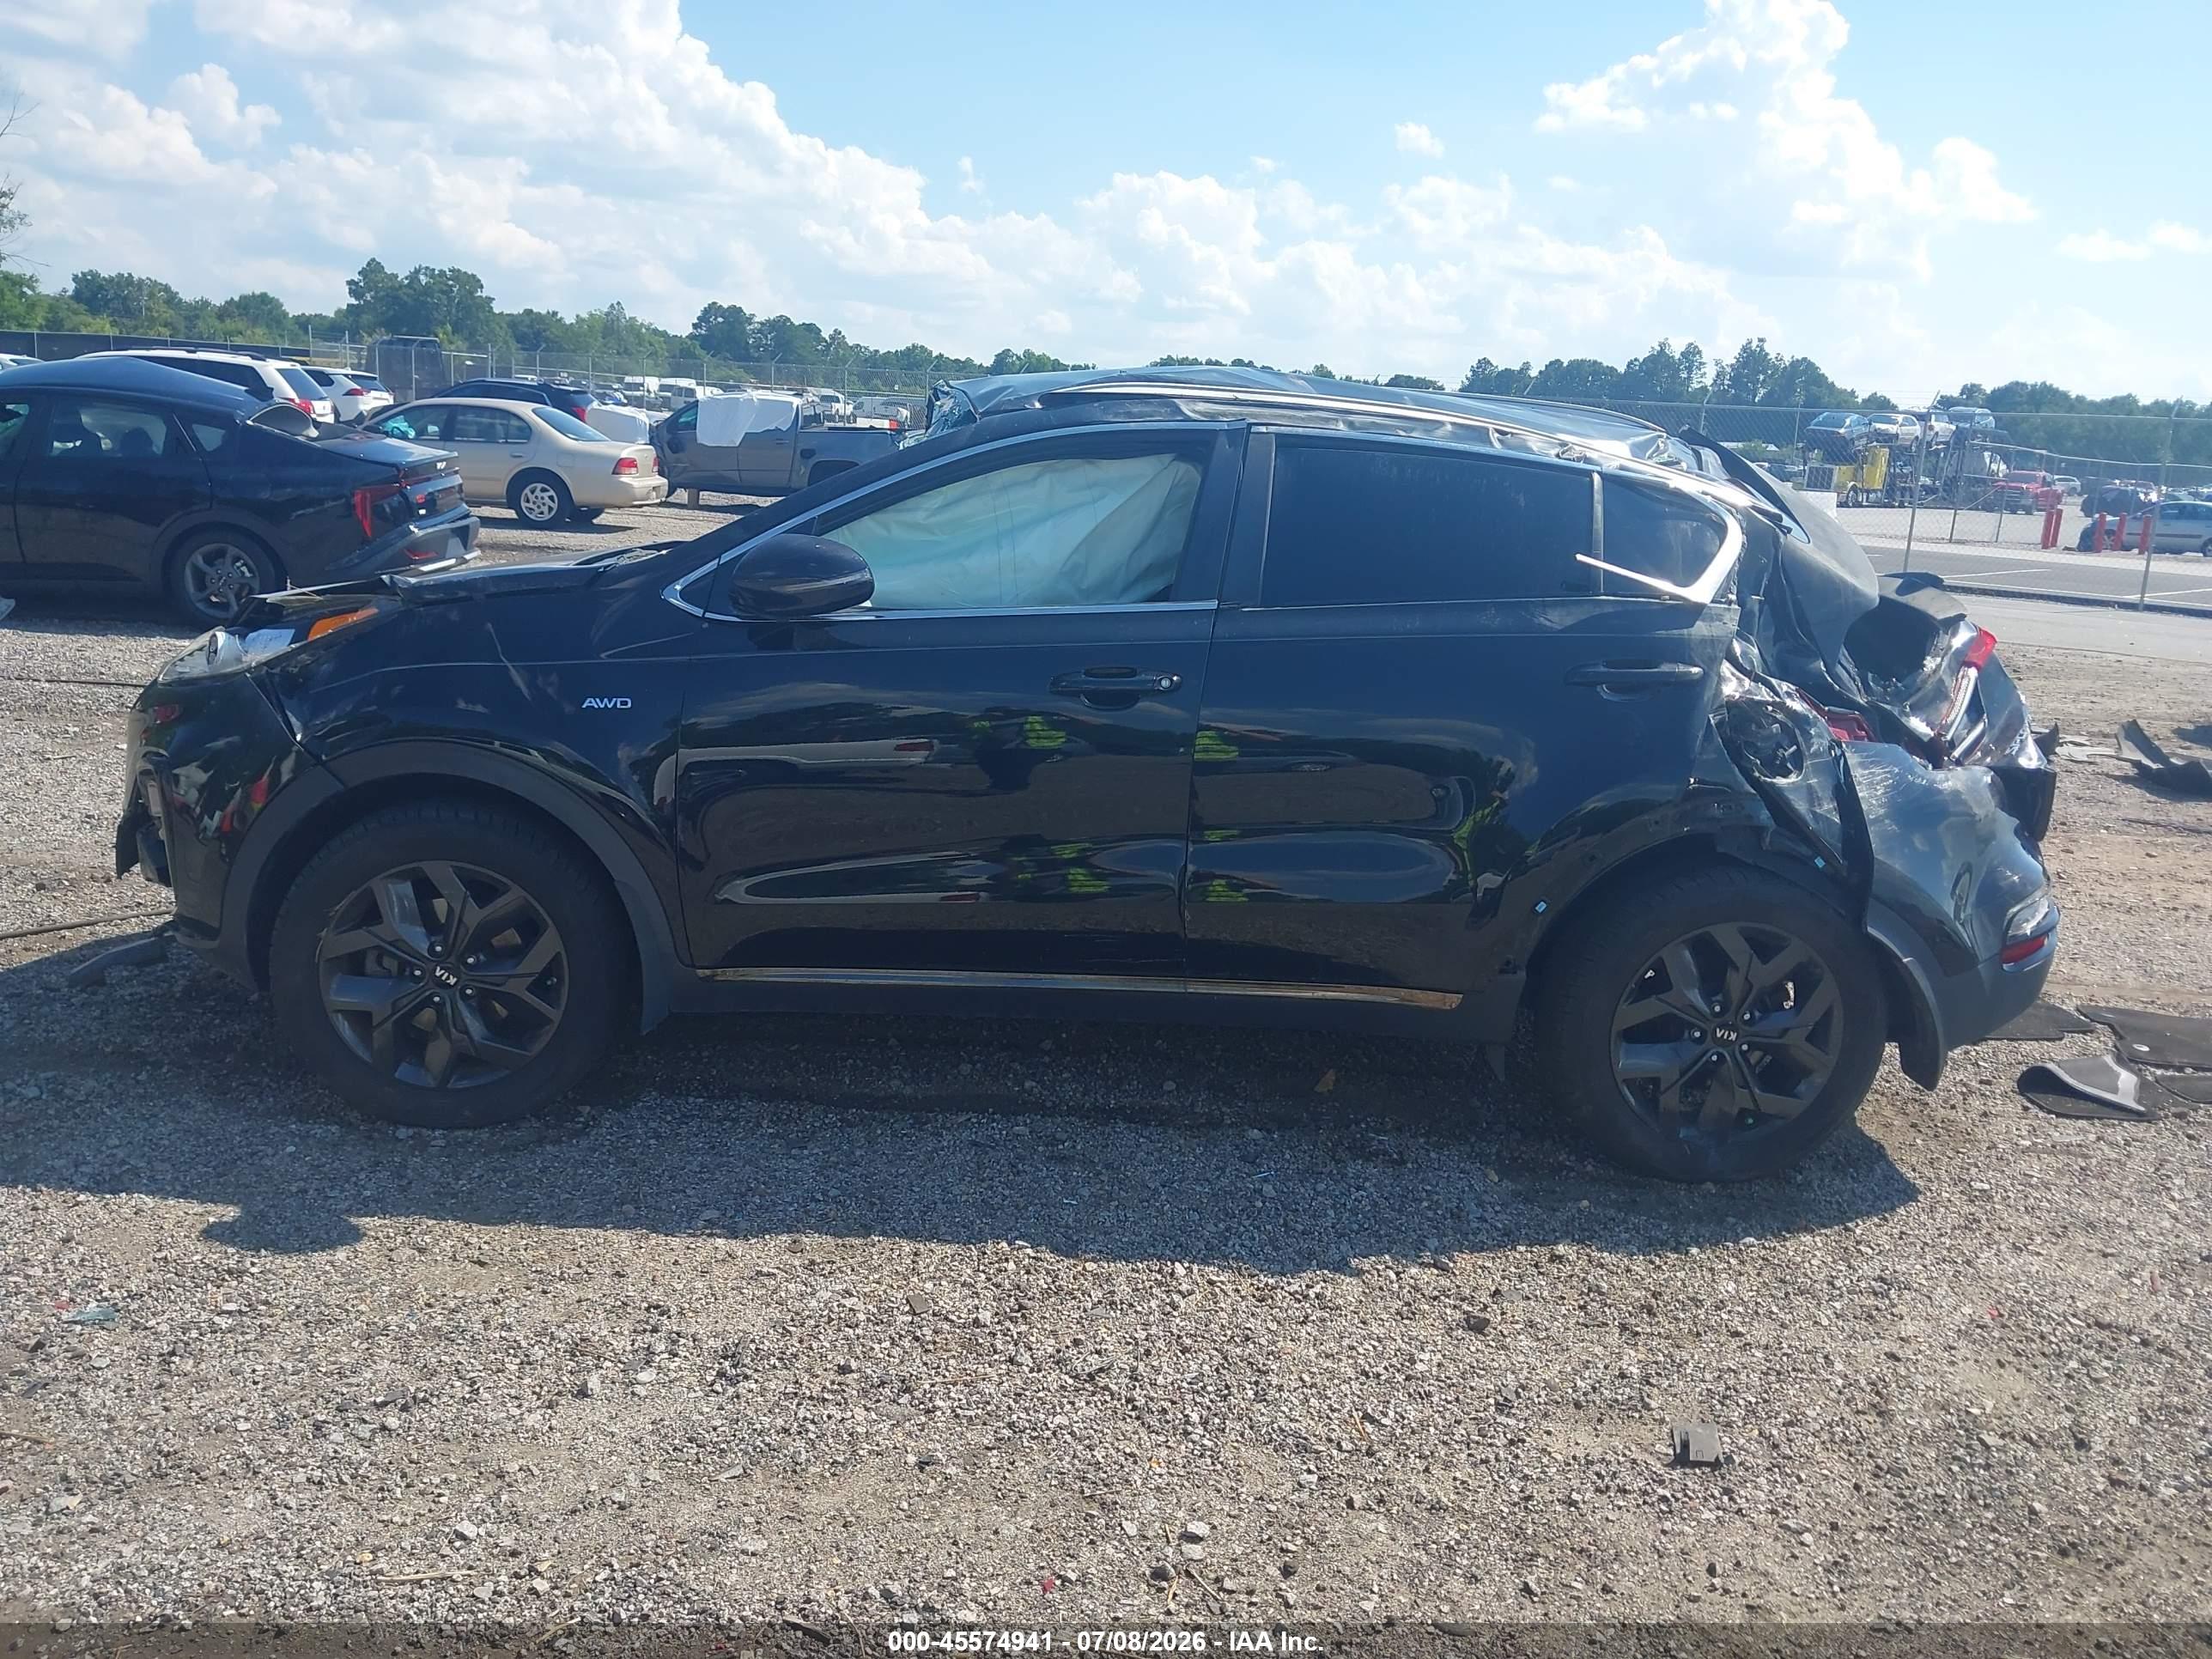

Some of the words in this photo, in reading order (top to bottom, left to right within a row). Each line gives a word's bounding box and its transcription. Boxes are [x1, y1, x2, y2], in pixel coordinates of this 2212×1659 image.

[581, 697, 632, 708] AWD
[434, 965, 458, 986] KIA
[1716, 1027, 1737, 1042] KIA
